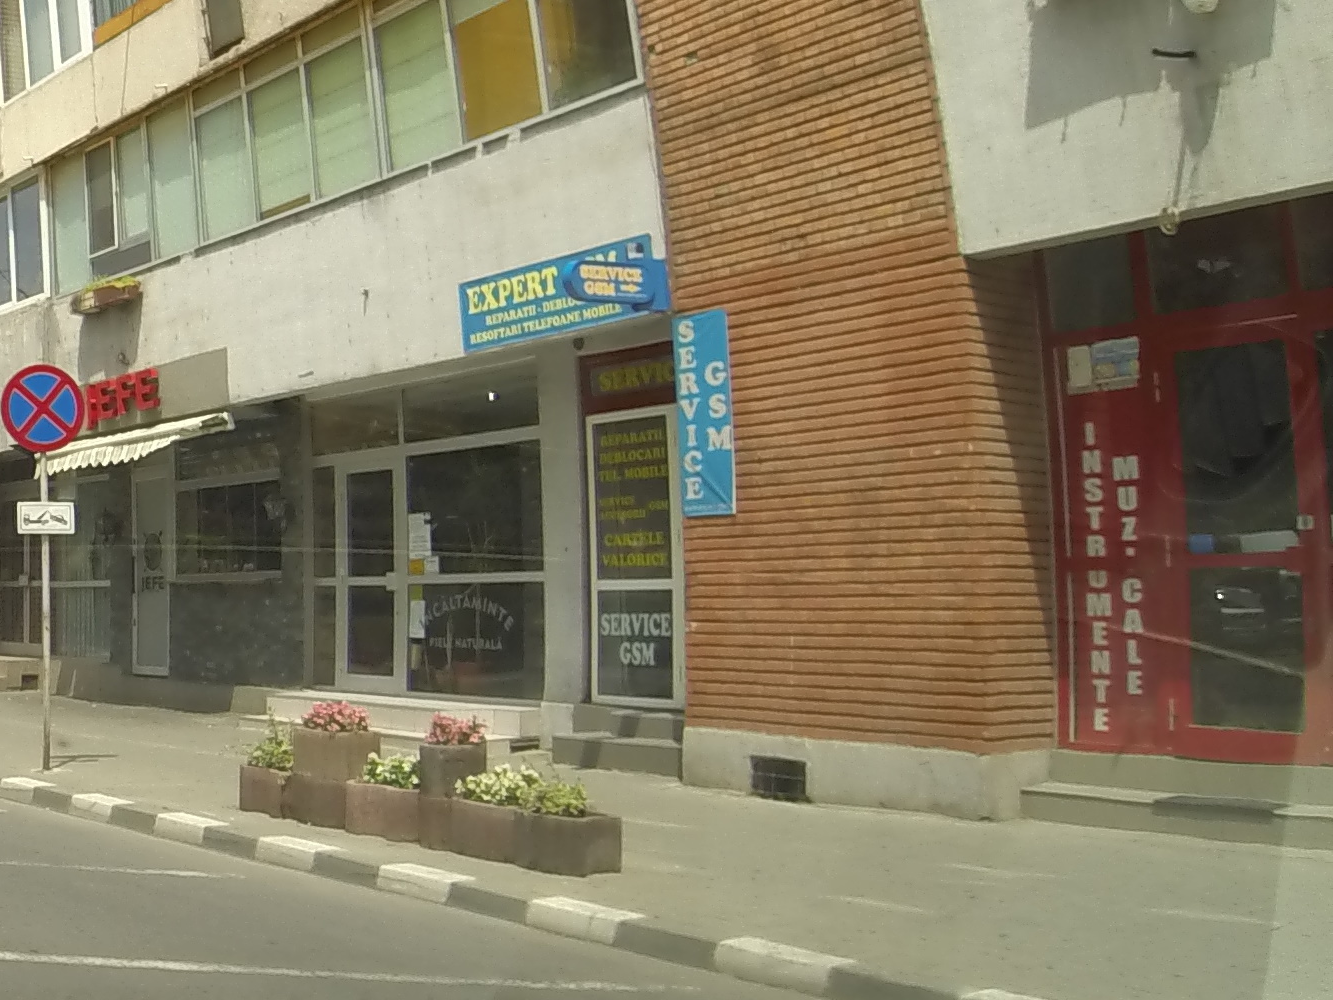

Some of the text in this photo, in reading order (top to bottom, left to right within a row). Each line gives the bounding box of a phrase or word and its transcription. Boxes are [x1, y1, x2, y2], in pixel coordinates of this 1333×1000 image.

[579, 265, 643, 283] SERVICE
[583, 281, 617, 297] GSM
[465, 265, 559, 315] EXPERT
[523, 313, 582, 333] TELEFOANE
[583, 303, 623, 321] MOBILE
[678, 320, 705, 500] SERVICE
[704, 360, 733, 452] GSM
[1082, 421, 1113, 732] INSTRUMENTE
[600, 612, 672, 638] SERVICE
[619, 642, 656, 667] GSM
